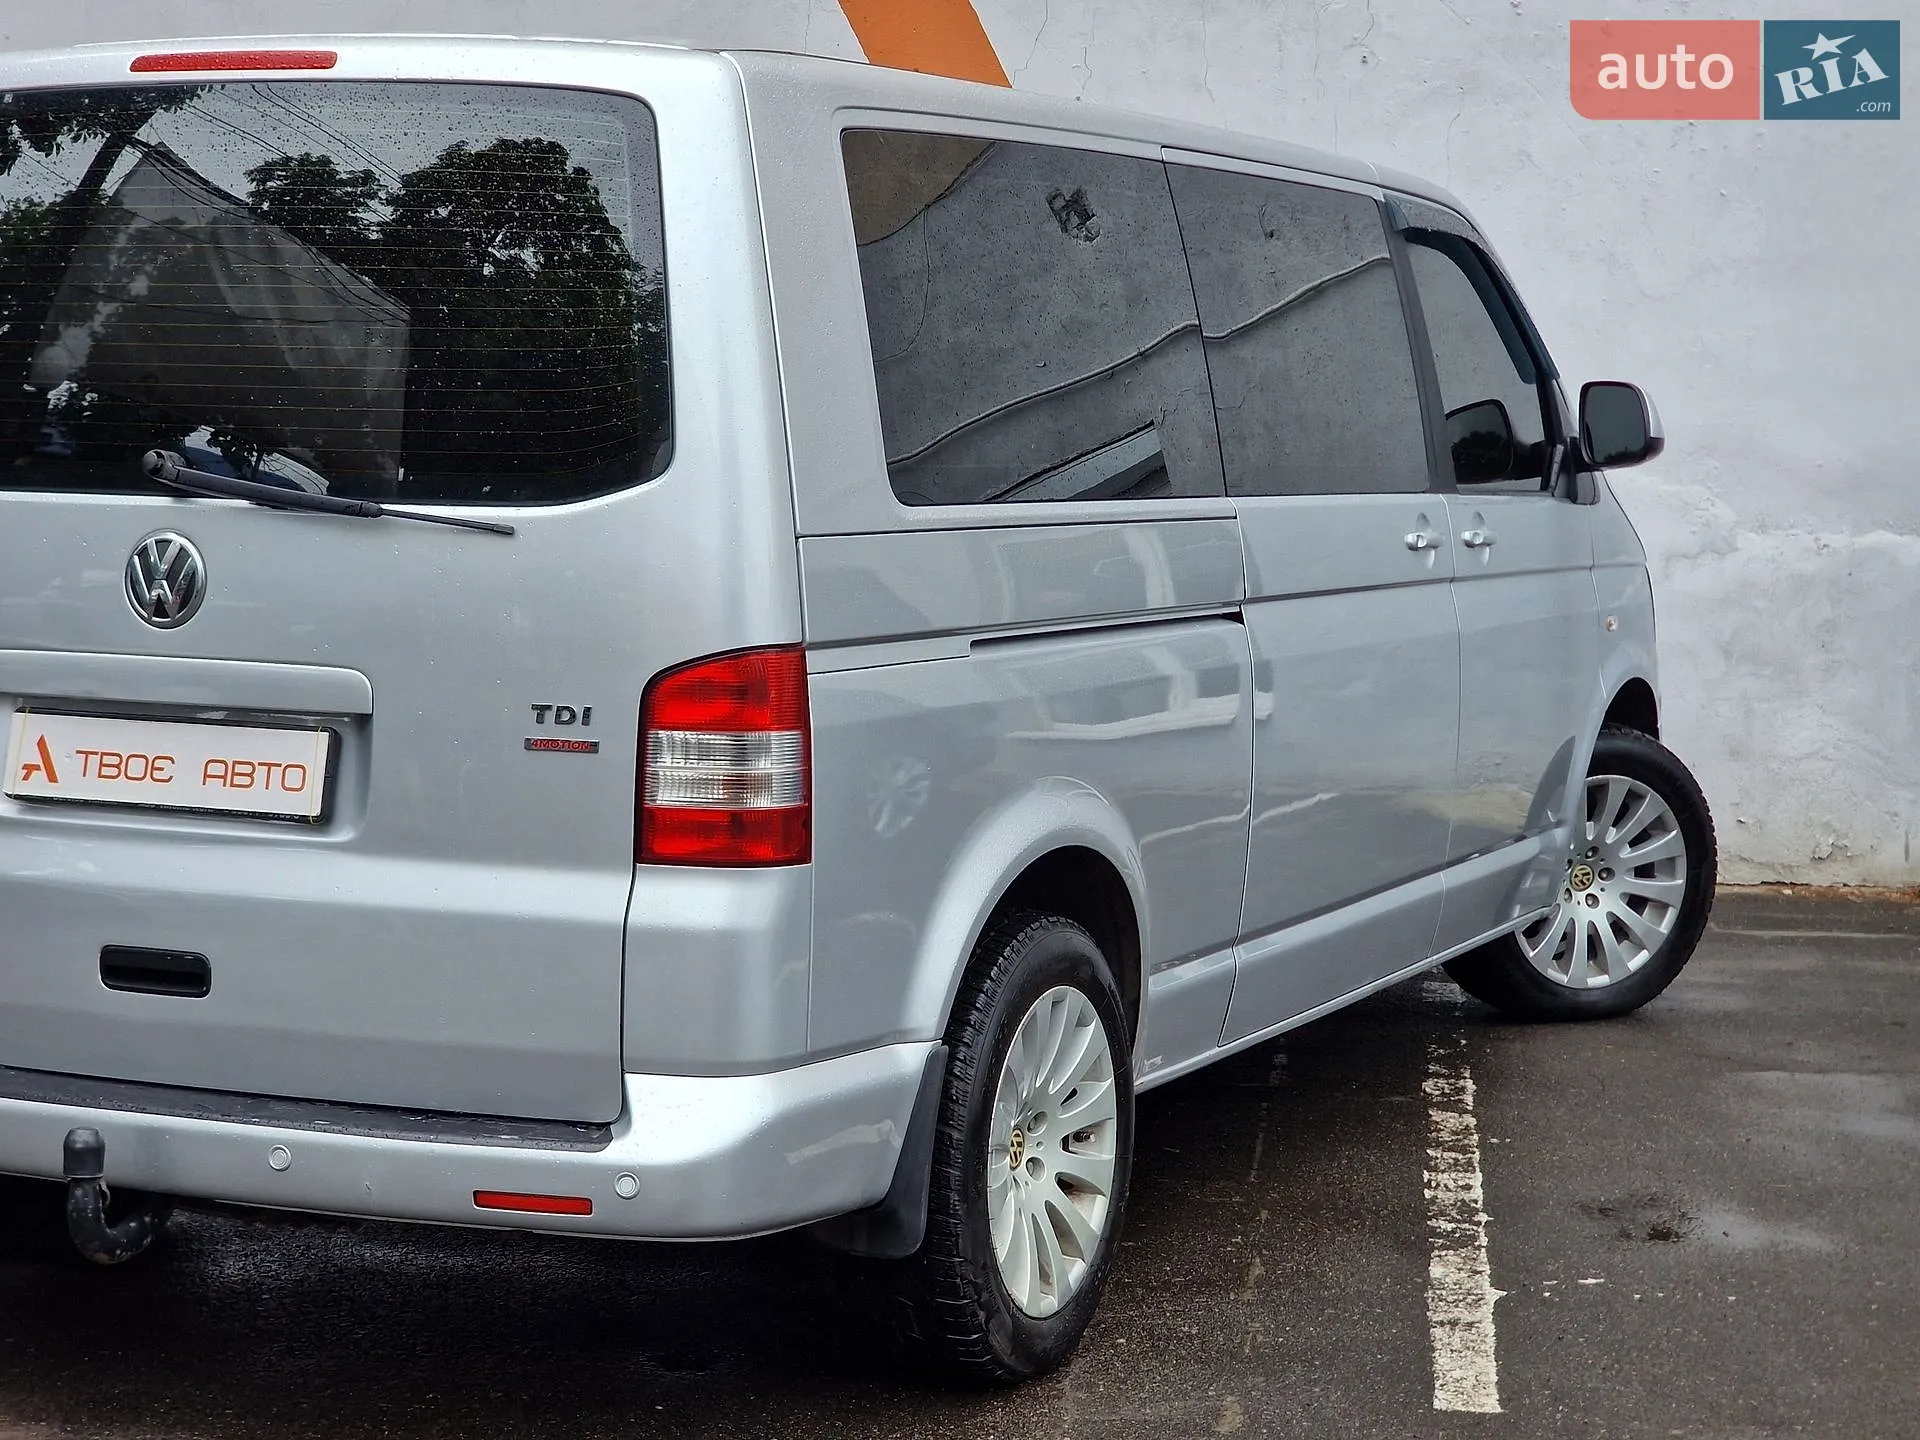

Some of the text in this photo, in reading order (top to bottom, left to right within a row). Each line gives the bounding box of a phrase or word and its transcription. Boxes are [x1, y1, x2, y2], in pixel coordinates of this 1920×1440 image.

[531, 703, 592, 726] TDI
[531, 739, 590, 751] 4MOTION
[201, 758, 308, 793] АВТО
